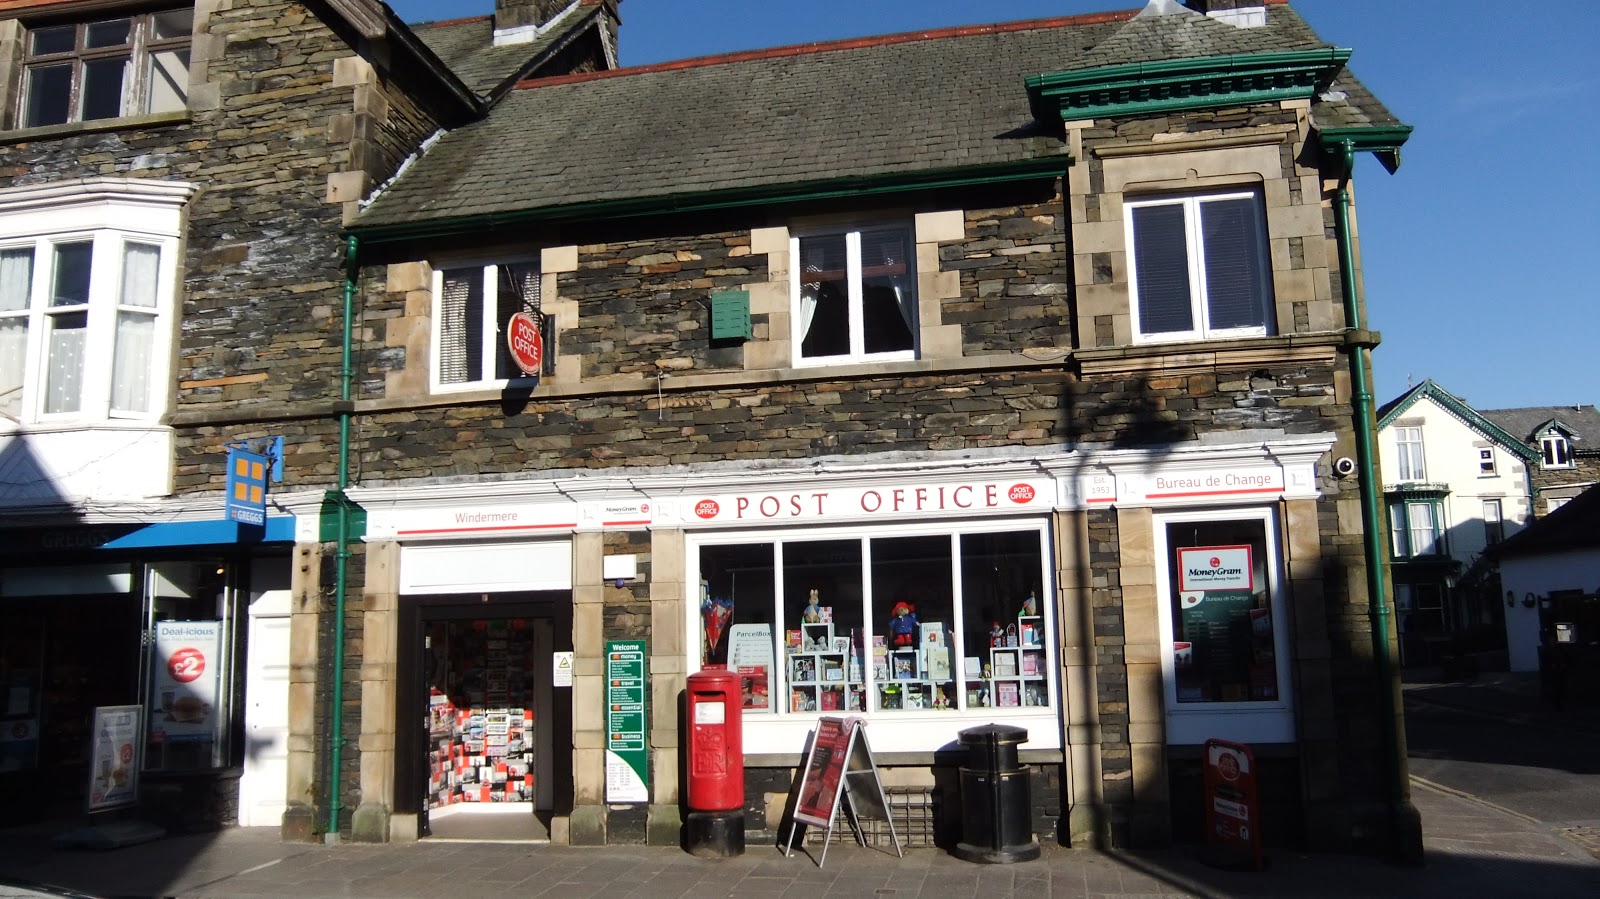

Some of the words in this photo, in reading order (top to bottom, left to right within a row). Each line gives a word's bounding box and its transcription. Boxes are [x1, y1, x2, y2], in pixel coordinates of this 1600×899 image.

[518, 323, 536, 343] POST
[514, 336, 538, 361] OFFICE
[1156, 477, 1201, 489] Bureau
[1206, 475, 1220, 487] de
[1225, 474, 1271, 488] Change
[1010, 492, 1033, 500] OFFICE
[1092, 486, 1110, 494] 1953
[736, 493, 828, 518] POST
[860, 484, 999, 513] OFFICE
[237, 510, 263, 523] GREGGS
[455, 512, 518, 523] Windermere
[1189, 568, 1241, 577] MoneyGram
[161, 627, 214, 636] Deal-icious
[612, 643, 640, 651] Welcome
[175, 656, 199, 675] £2
